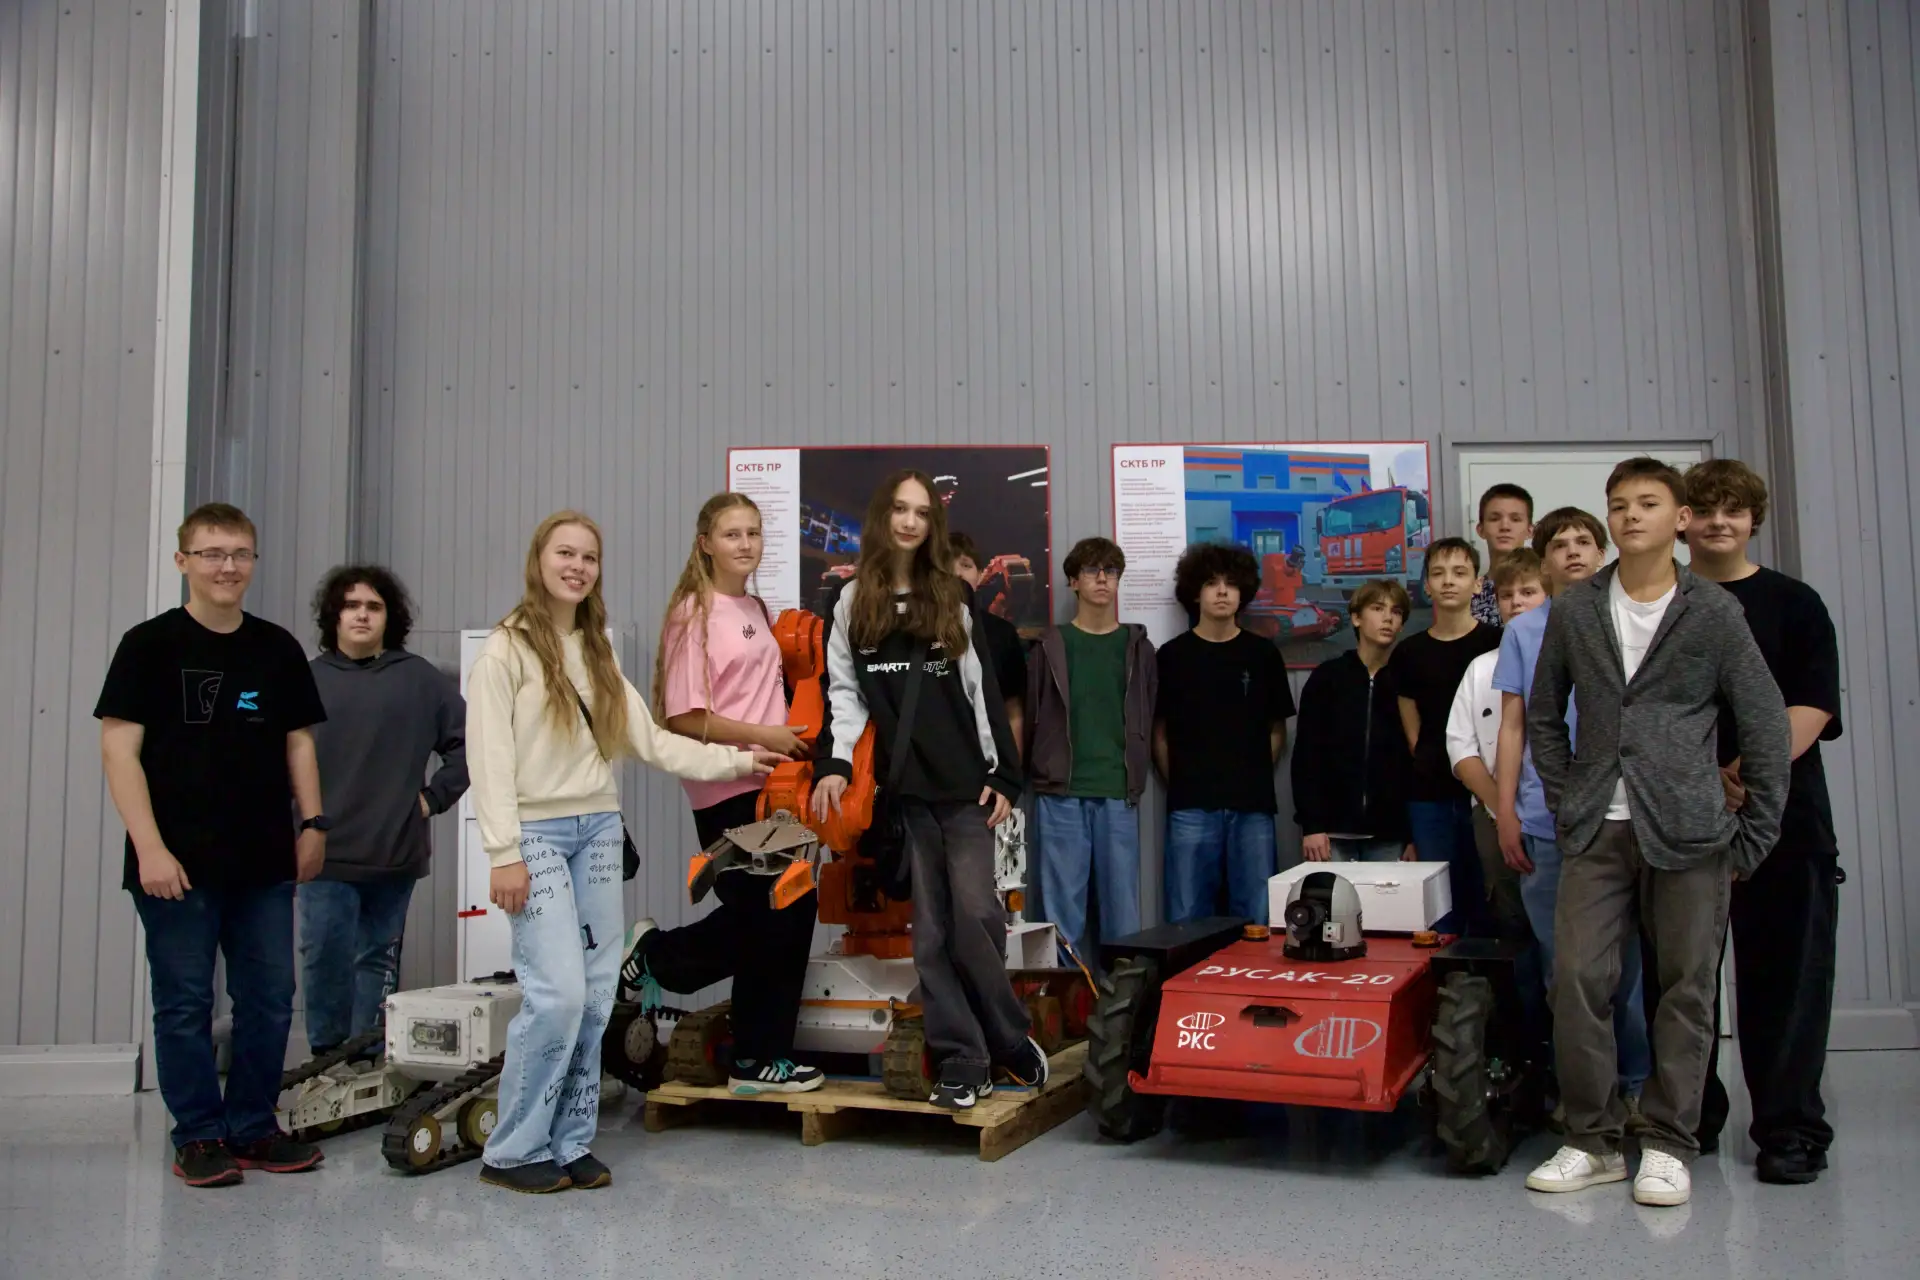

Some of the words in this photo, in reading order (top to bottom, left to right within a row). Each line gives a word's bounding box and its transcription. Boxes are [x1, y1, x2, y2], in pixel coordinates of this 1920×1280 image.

[735, 463, 765, 472] СКТБ
[766, 463, 782, 472] ПР
[1120, 459, 1149, 468] СКТБ
[1151, 459, 1166, 468] ПР
[1196, 965, 1395, 986] РУСАК-20
[1177, 1030, 1216, 1050] РКС
